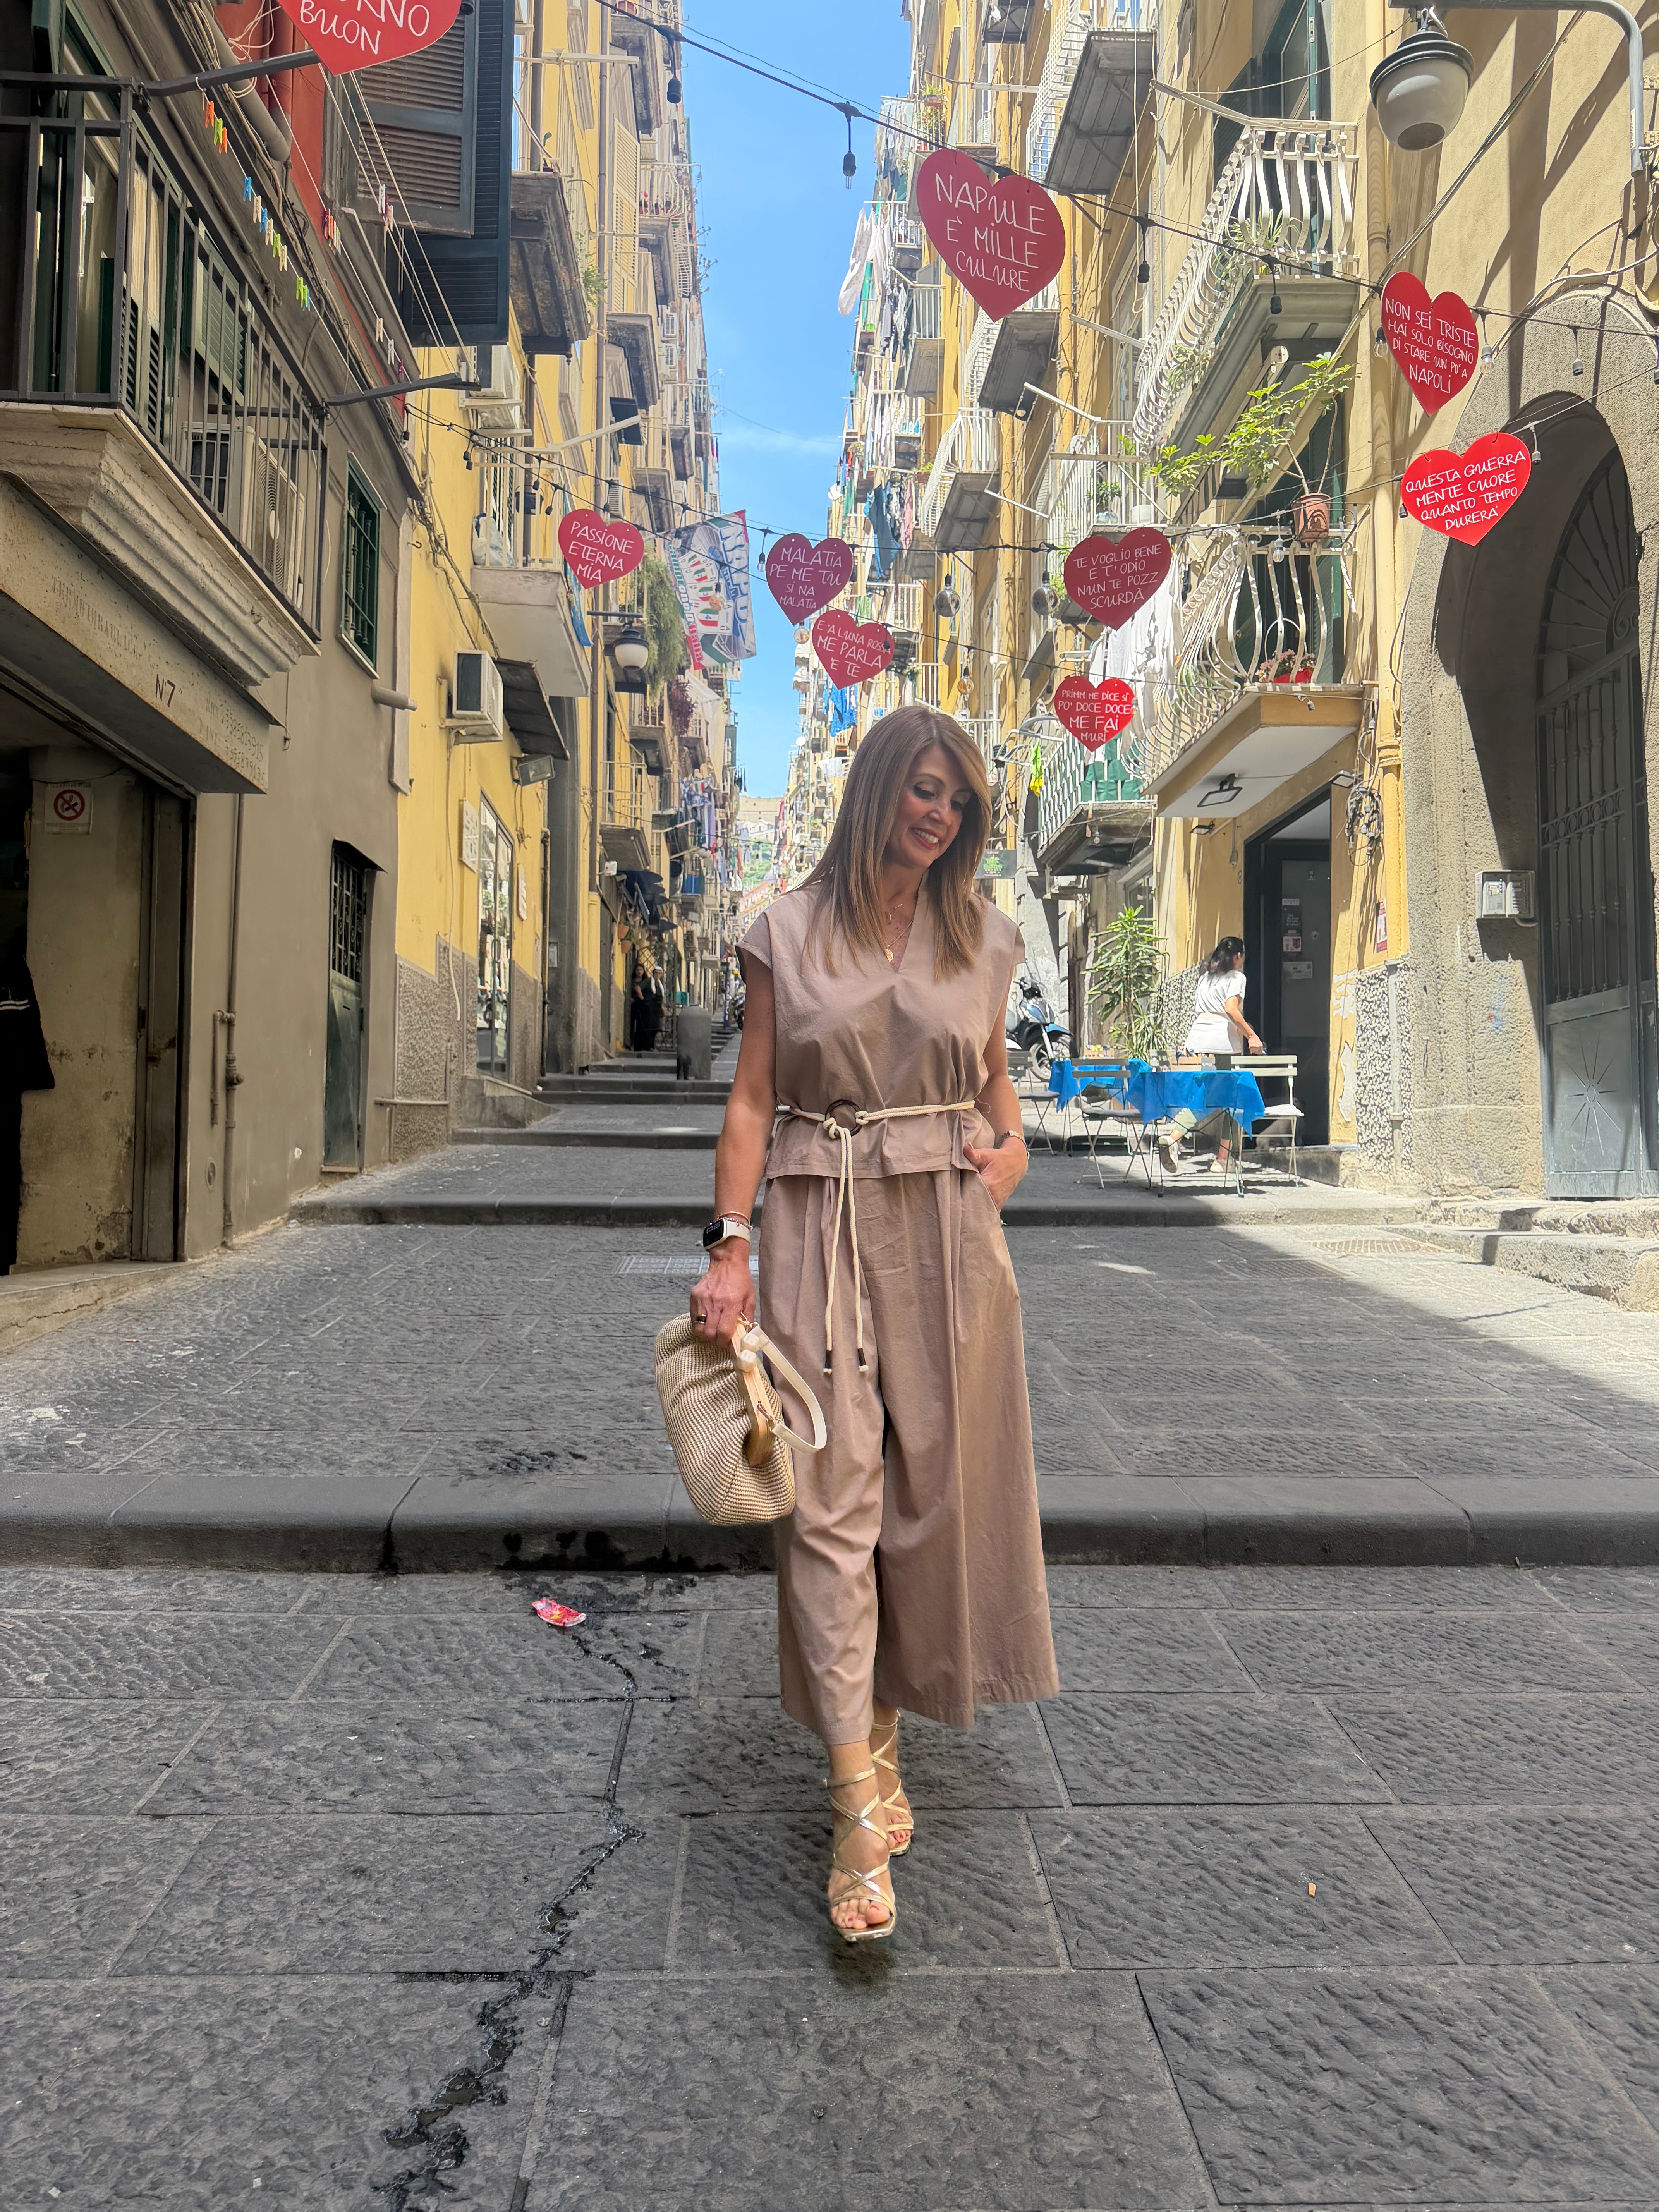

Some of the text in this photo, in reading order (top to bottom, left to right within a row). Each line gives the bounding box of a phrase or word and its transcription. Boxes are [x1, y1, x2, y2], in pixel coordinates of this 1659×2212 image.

[300, 0, 381, 55] BUON
[936, 173, 1046, 235] NAPULE
[974, 223, 1039, 269] MILLE
[956, 251, 1030, 292] CULURE
[1385, 297, 1475, 349] NON SEI TRISTE
[1388, 319, 1407, 337] HAI
[1437, 338, 1473, 364] BISOGNO
[1393, 337, 1401, 351] DI
[1404, 343, 1431, 363] STARE
[1433, 356, 1447, 370] UN
[1462, 369, 1468, 378] A
[1409, 364, 1451, 393] NAPOLI
[1406, 450, 1527, 493] QUESTA GUERRA
[1416, 469, 1516, 507] MENTE CUORE
[1421, 487, 1518, 521] QUANTO TEMPO
[570, 521, 635, 555] PASSIONE
[568, 541, 624, 572] ETERNA
[781, 547, 842, 568] MALATIA
[1073, 543, 1162, 568] TE VOGLIO BENE
[577, 563, 601, 582] MIA
[769, 563, 842, 586] PE ME TU
[1077, 572, 1159, 597] NUN TE POZZ
[1089, 568, 1097, 580] E
[779, 596, 816, 609] MALATIA
[799, 585, 815, 596] NA
[817, 620, 825, 630] E
[838, 627, 864, 645] LUNA
[817, 635, 882, 669] ME PARLA
[844, 661, 861, 678] TE
[1062, 689, 1085, 699] PRIMM
[1101, 691, 1120, 701] DICE
[1076, 702, 1102, 713] DOCE
[1105, 704, 1131, 715] DOCE
[1069, 715, 1119, 731] ME FAI
